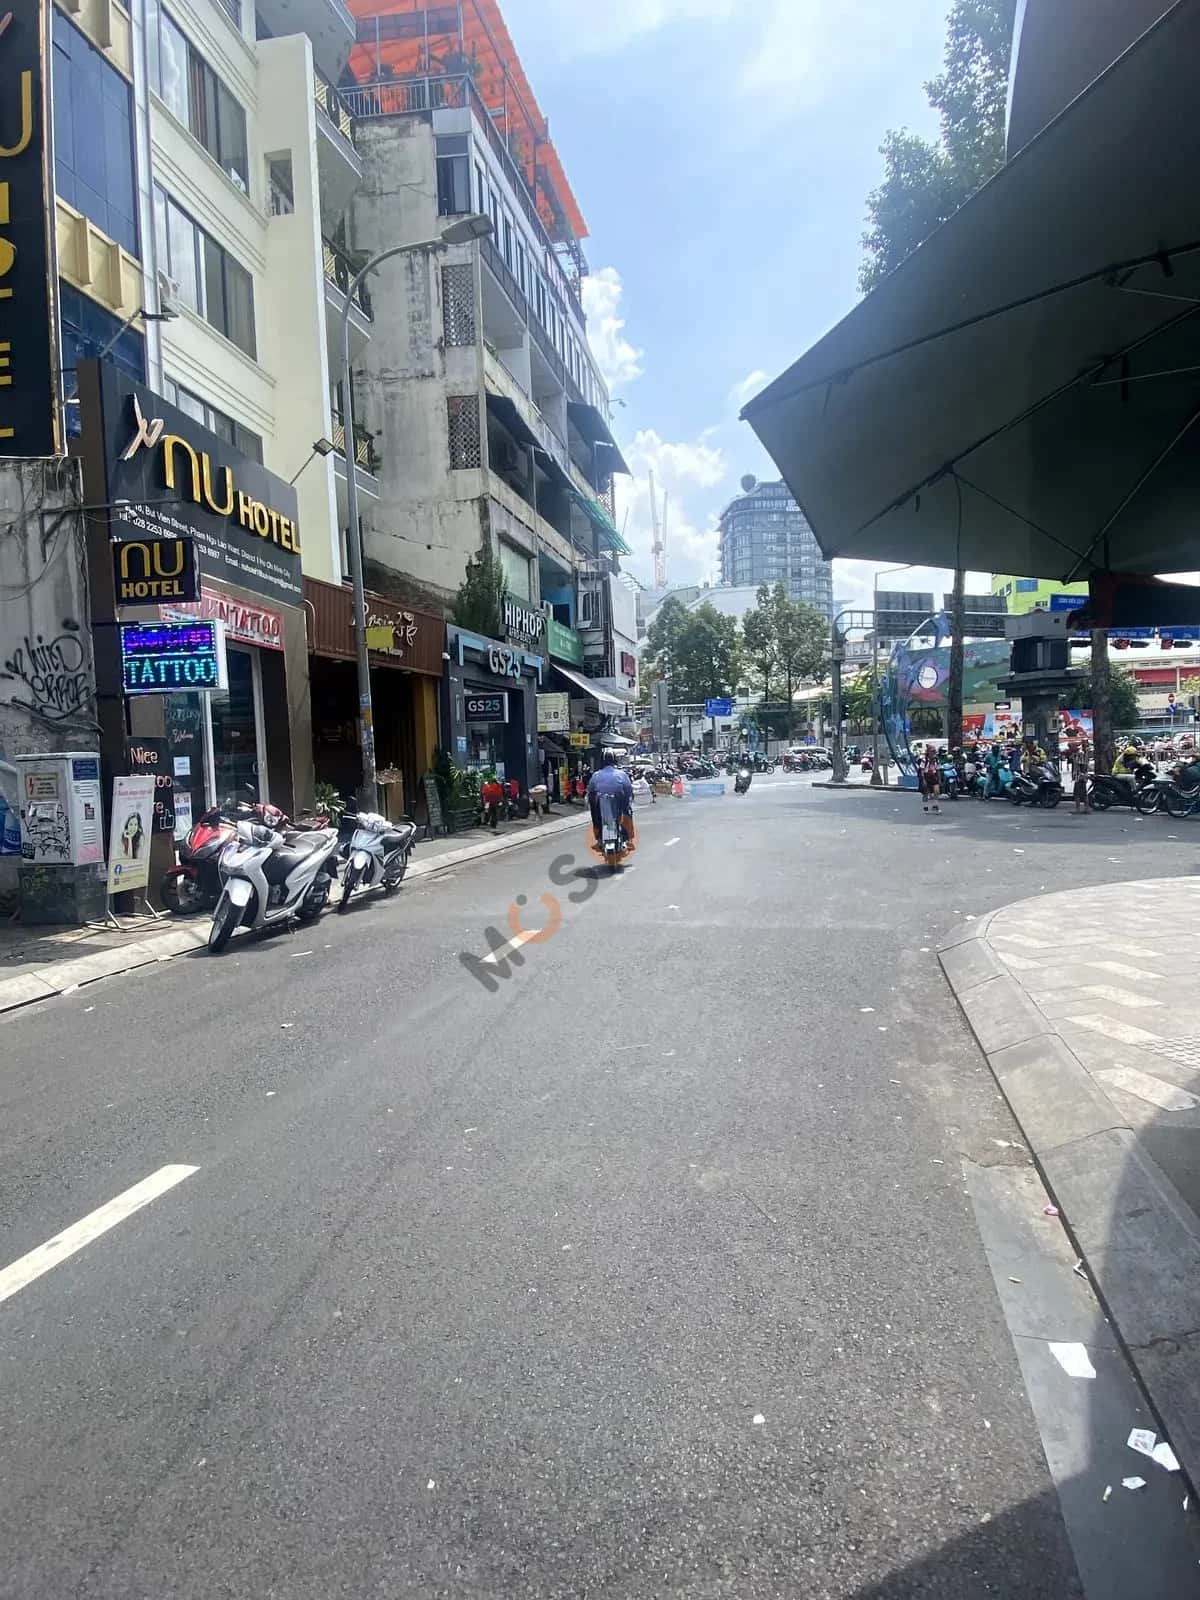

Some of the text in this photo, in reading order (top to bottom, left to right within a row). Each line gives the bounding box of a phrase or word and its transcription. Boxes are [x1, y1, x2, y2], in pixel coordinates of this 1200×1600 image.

[239, 490, 302, 554] HOTEL
[121, 580, 184, 599] HOTEL
[125, 657, 217, 684] TATTOO
[489, 646, 521, 680] GS25
[468, 700, 500, 713] GS25
[130, 746, 159, 765] Nice
